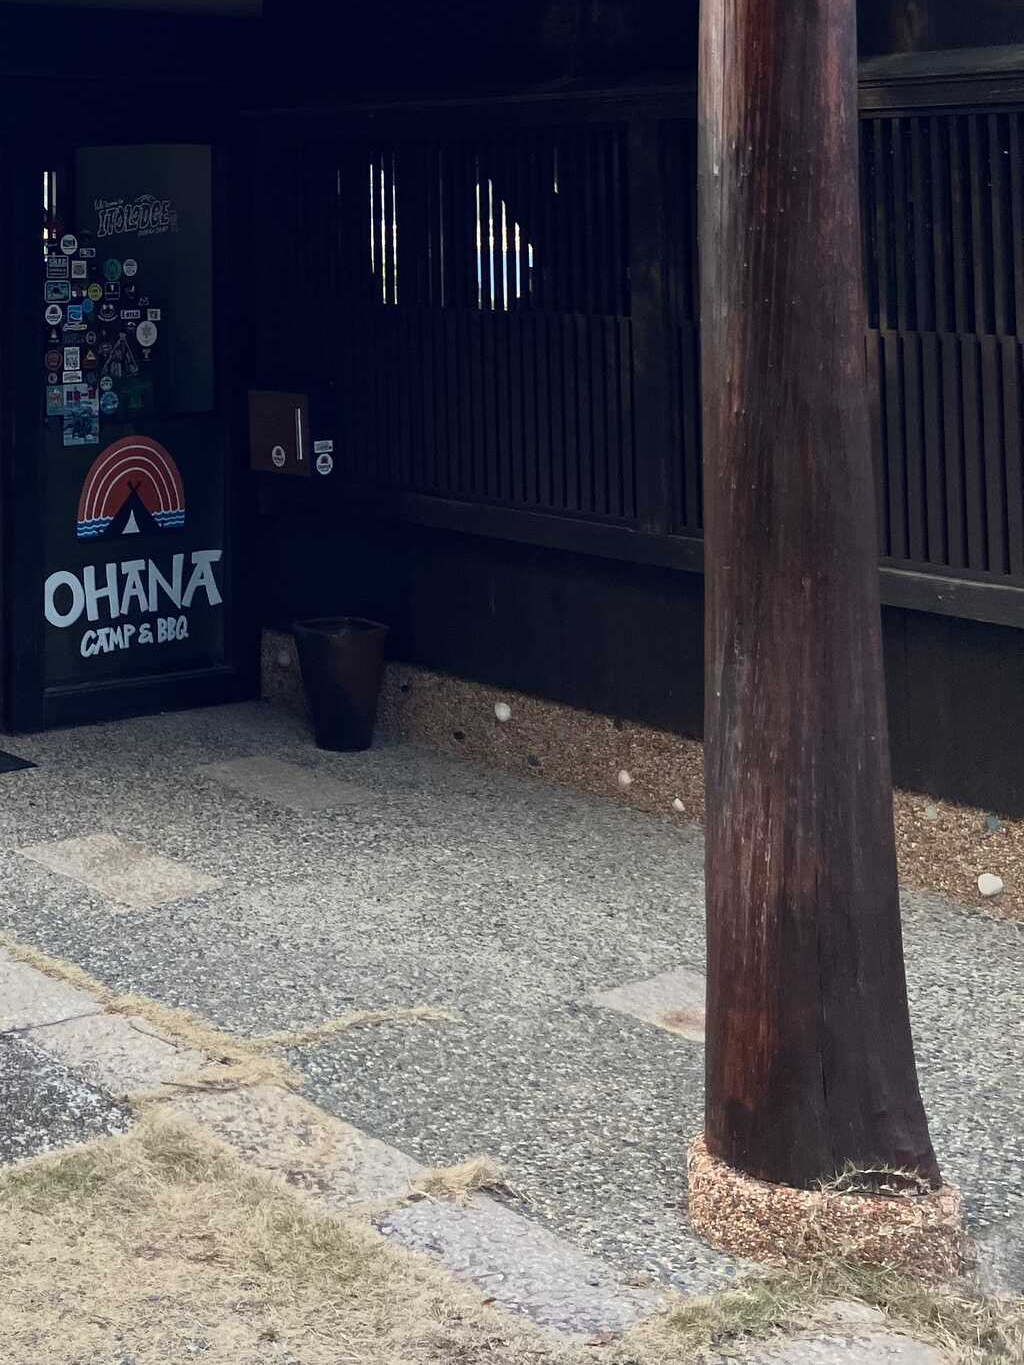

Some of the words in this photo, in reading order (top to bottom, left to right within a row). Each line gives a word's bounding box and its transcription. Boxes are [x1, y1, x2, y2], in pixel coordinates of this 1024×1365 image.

[44, 550, 223, 627] OHANA
[80, 623, 136, 658] CAMP
[138, 622, 154, 644] &
[157, 615, 189, 643] BBQ
